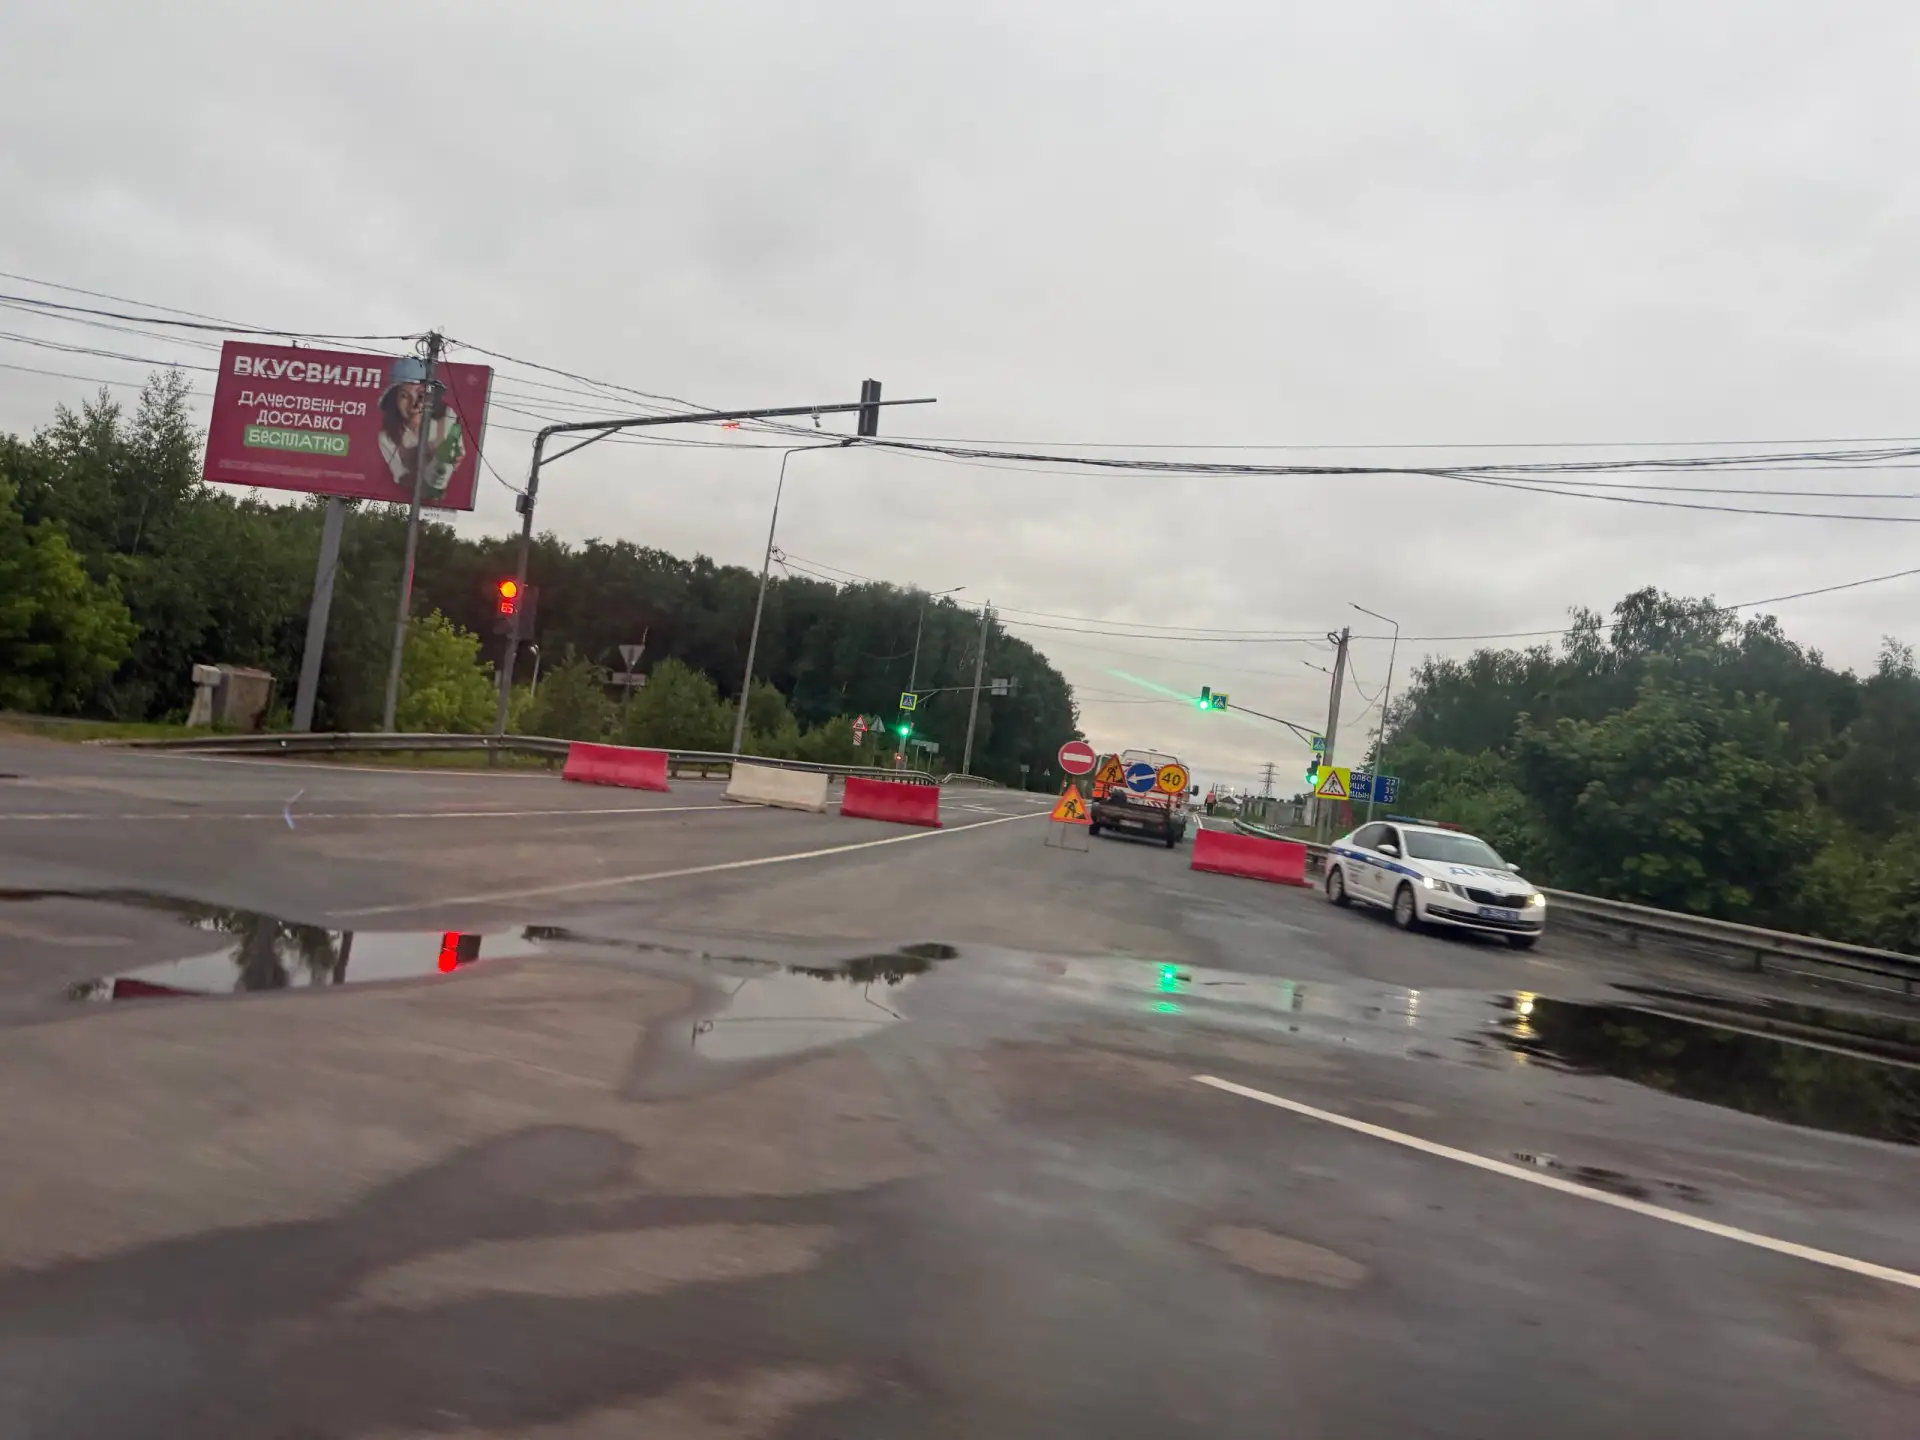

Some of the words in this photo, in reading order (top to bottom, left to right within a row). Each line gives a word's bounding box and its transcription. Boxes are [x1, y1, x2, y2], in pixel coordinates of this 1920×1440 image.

[233, 355, 382, 389] ВКУСВИЛЛ
[501, 602, 514, 614] 65
[1162, 772, 1181, 786] 40
